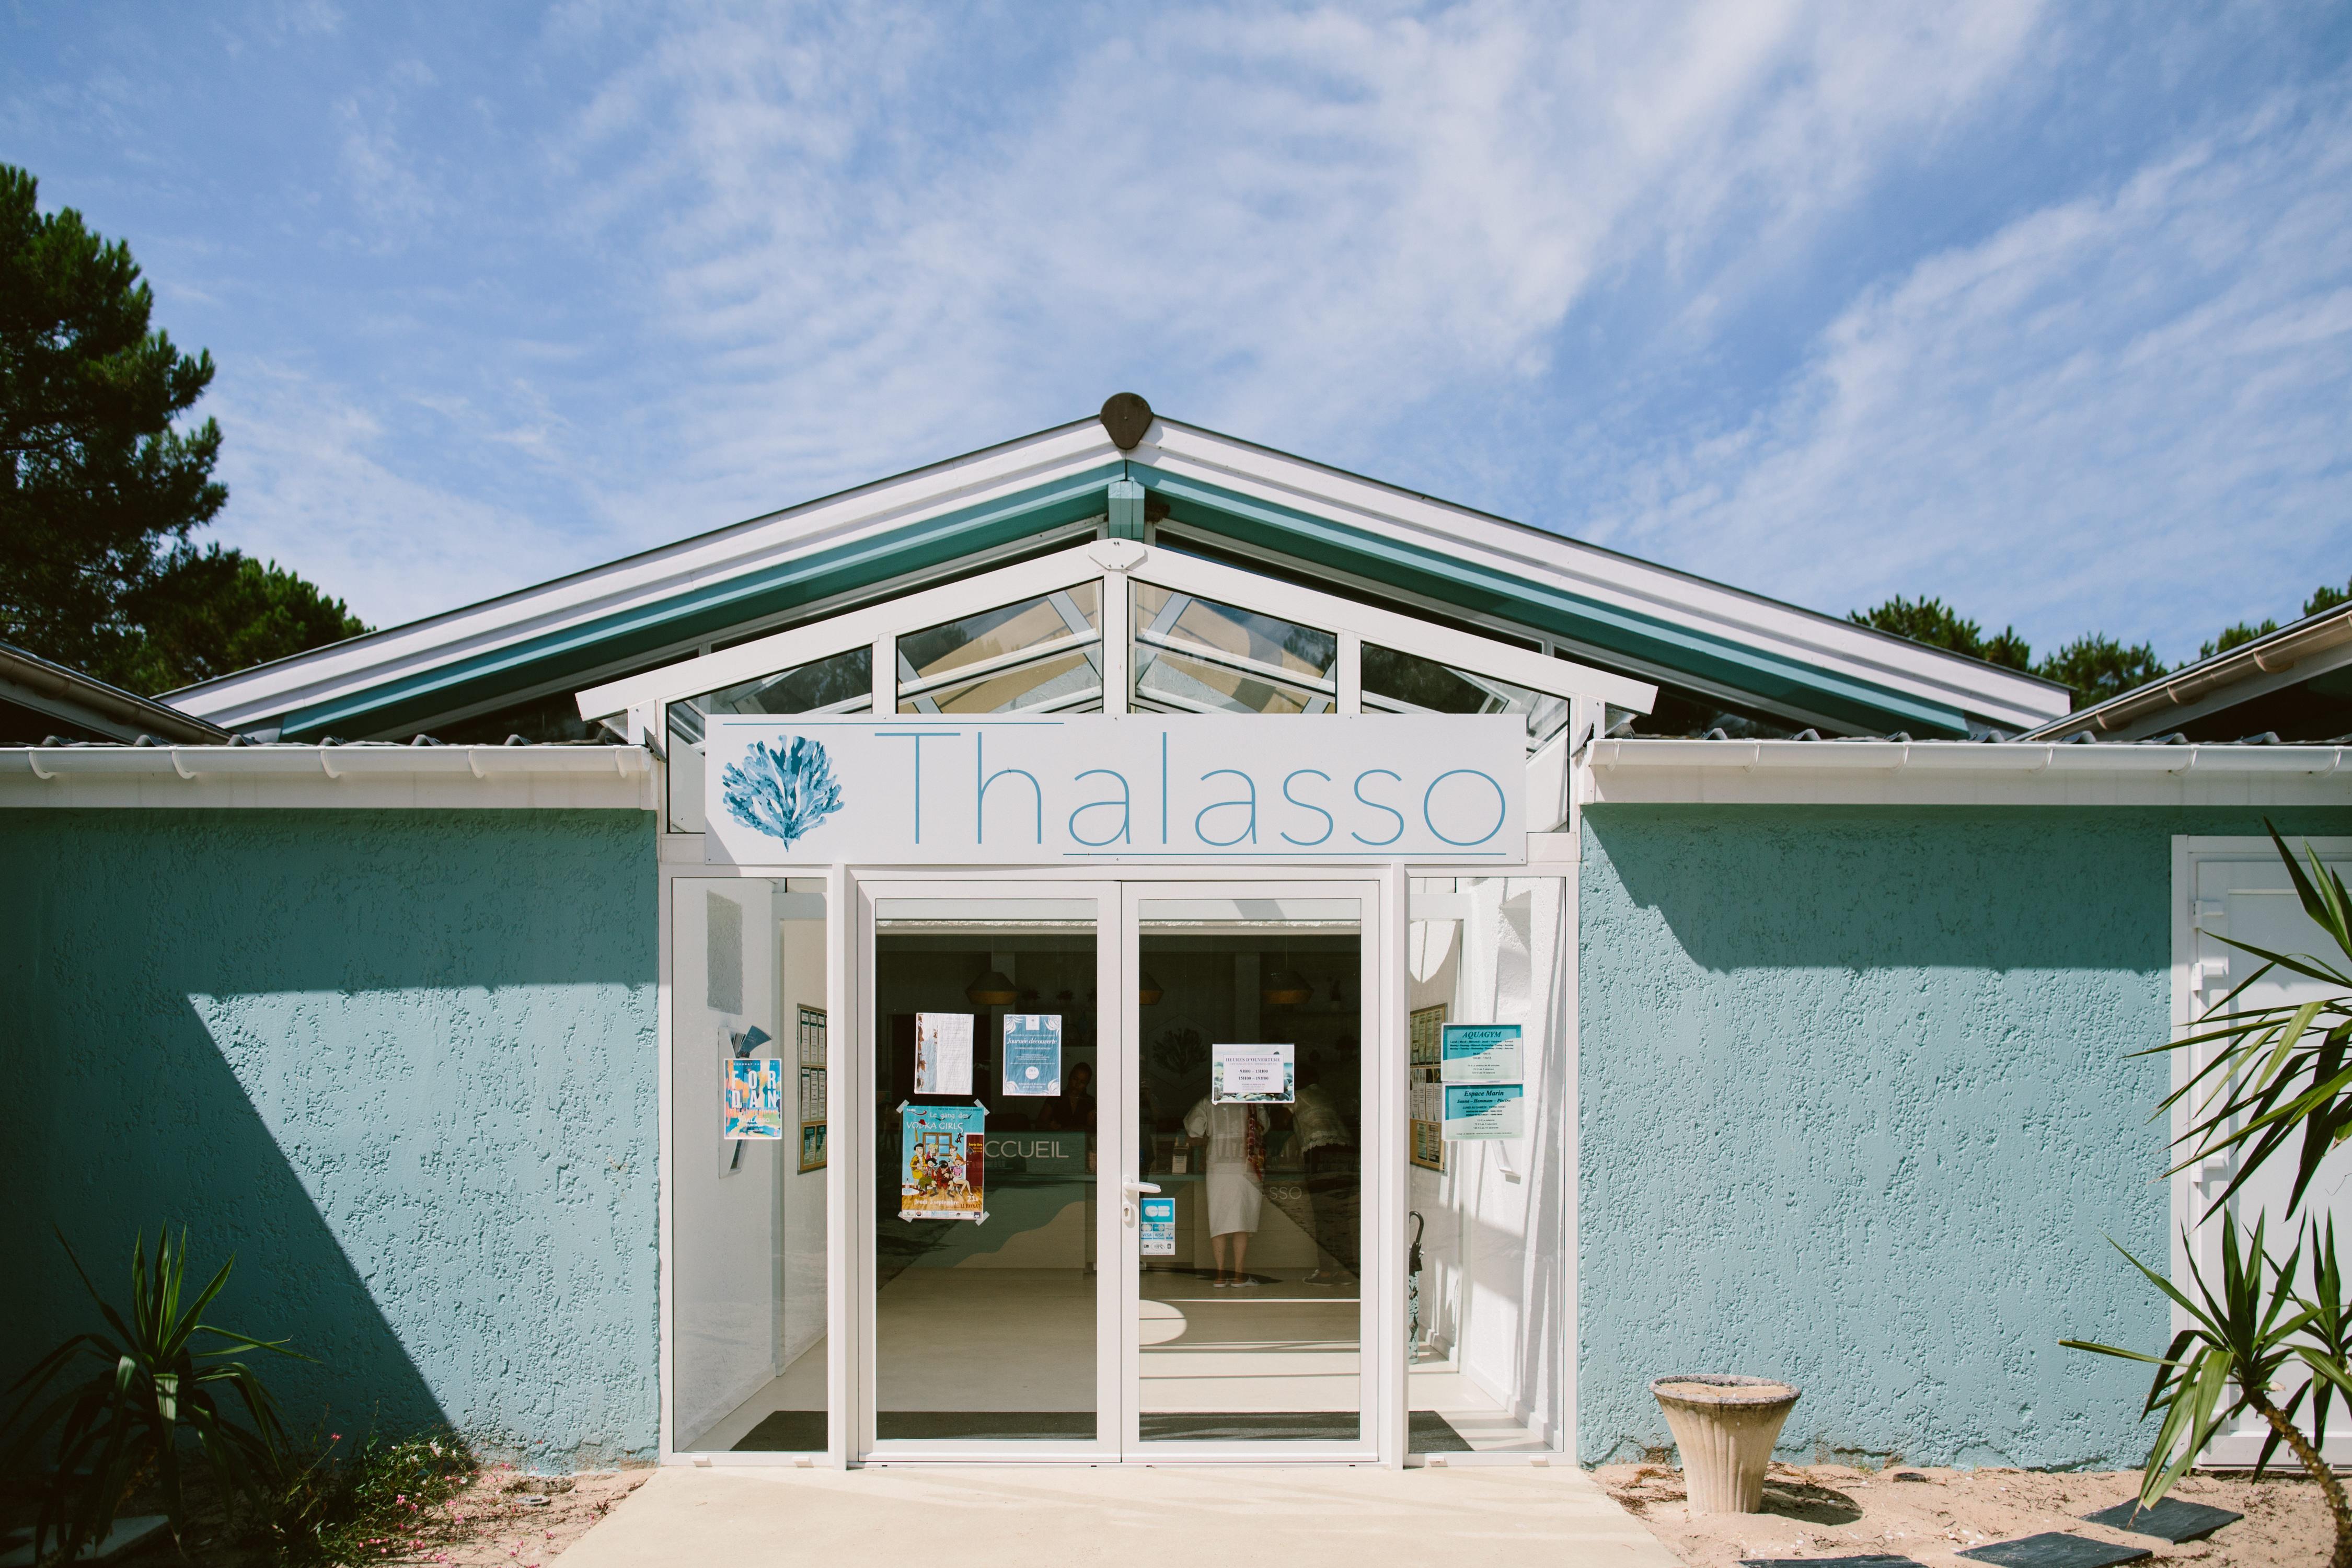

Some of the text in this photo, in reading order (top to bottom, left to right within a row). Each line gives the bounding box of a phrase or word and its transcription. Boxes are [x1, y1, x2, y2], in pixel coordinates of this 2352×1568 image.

[874, 731, 1506, 846] Thalasso
[731, 1070, 776, 1089] FOR
[731, 1090, 777, 1108] DAN
[939, 1122, 964, 1134] GIRLS
[985, 1140, 1069, 1158] CCUEIL
[1269, 1186, 1302, 1200] SSO
